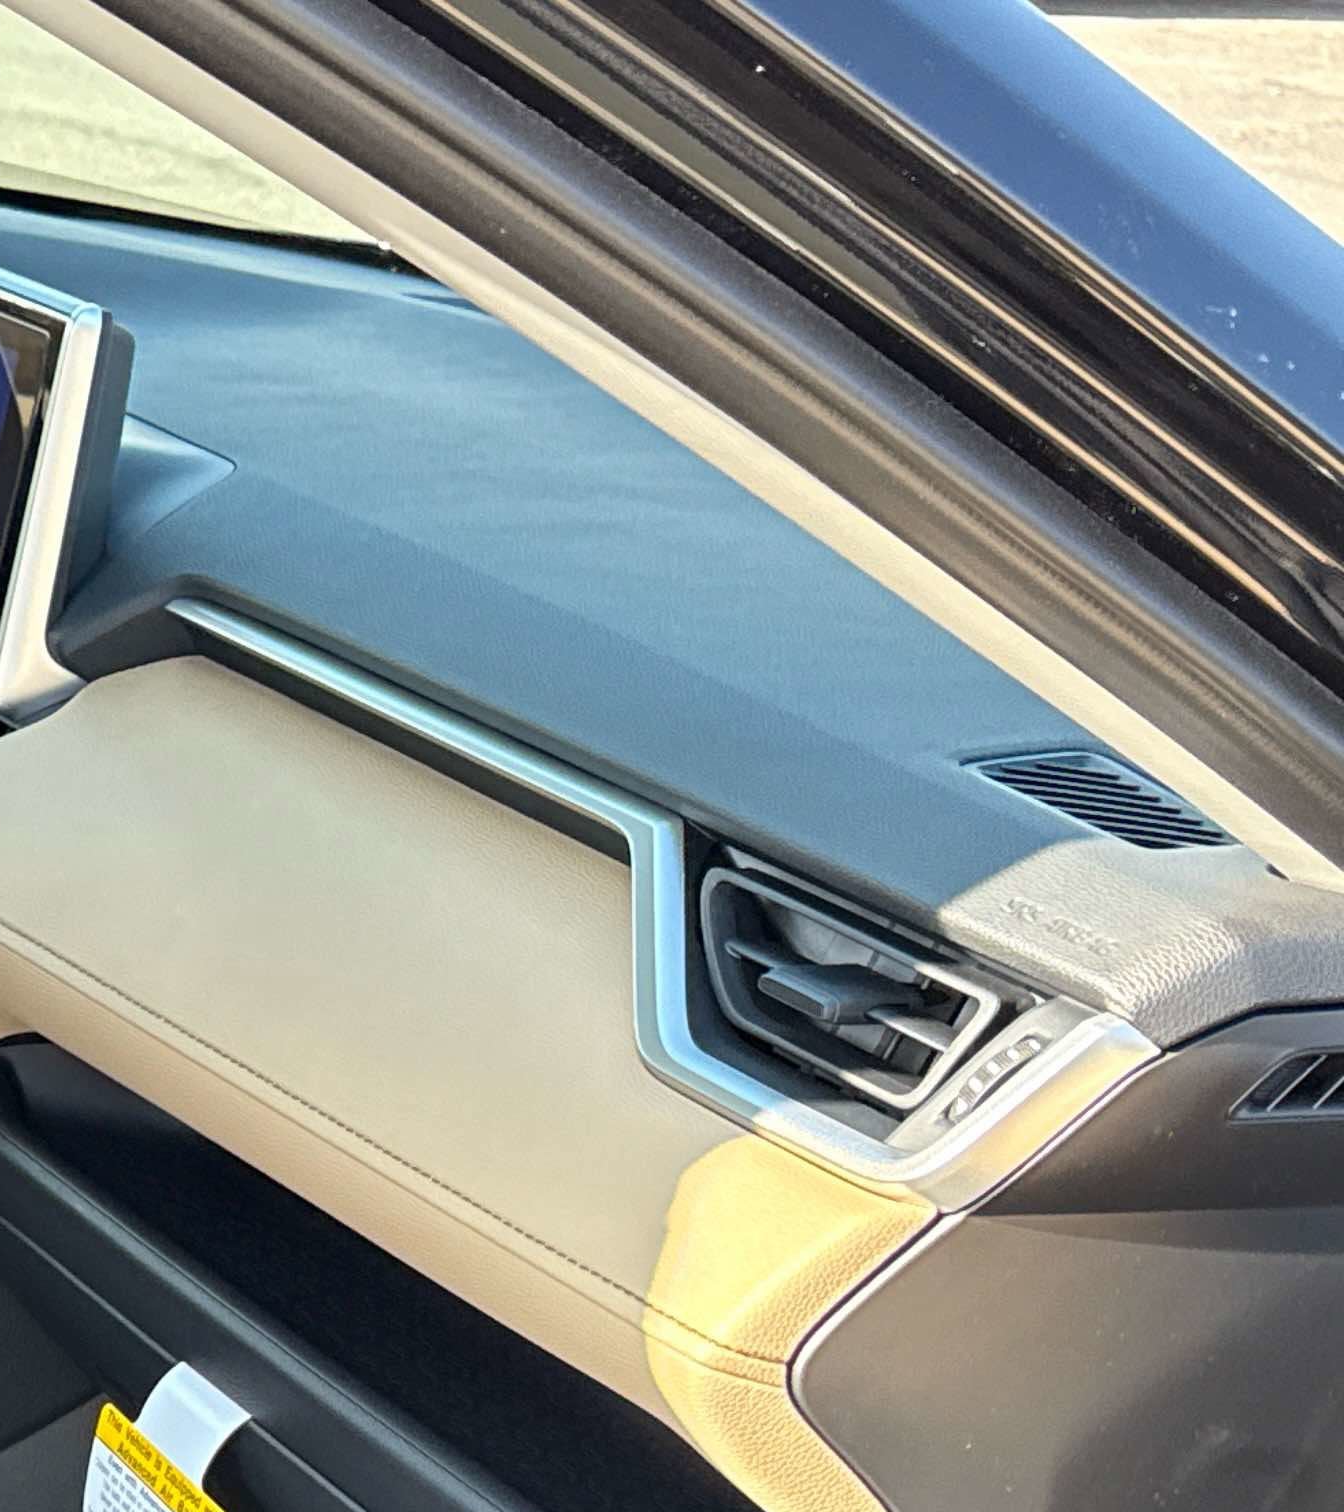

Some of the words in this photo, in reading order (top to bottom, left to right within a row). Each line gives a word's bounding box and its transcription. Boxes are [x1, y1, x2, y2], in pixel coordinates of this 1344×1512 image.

[116, 1441, 158, 1488] Advanced
[126, 1425, 153, 1462] Vehicle
[164, 1464, 202, 1509] Equipped
